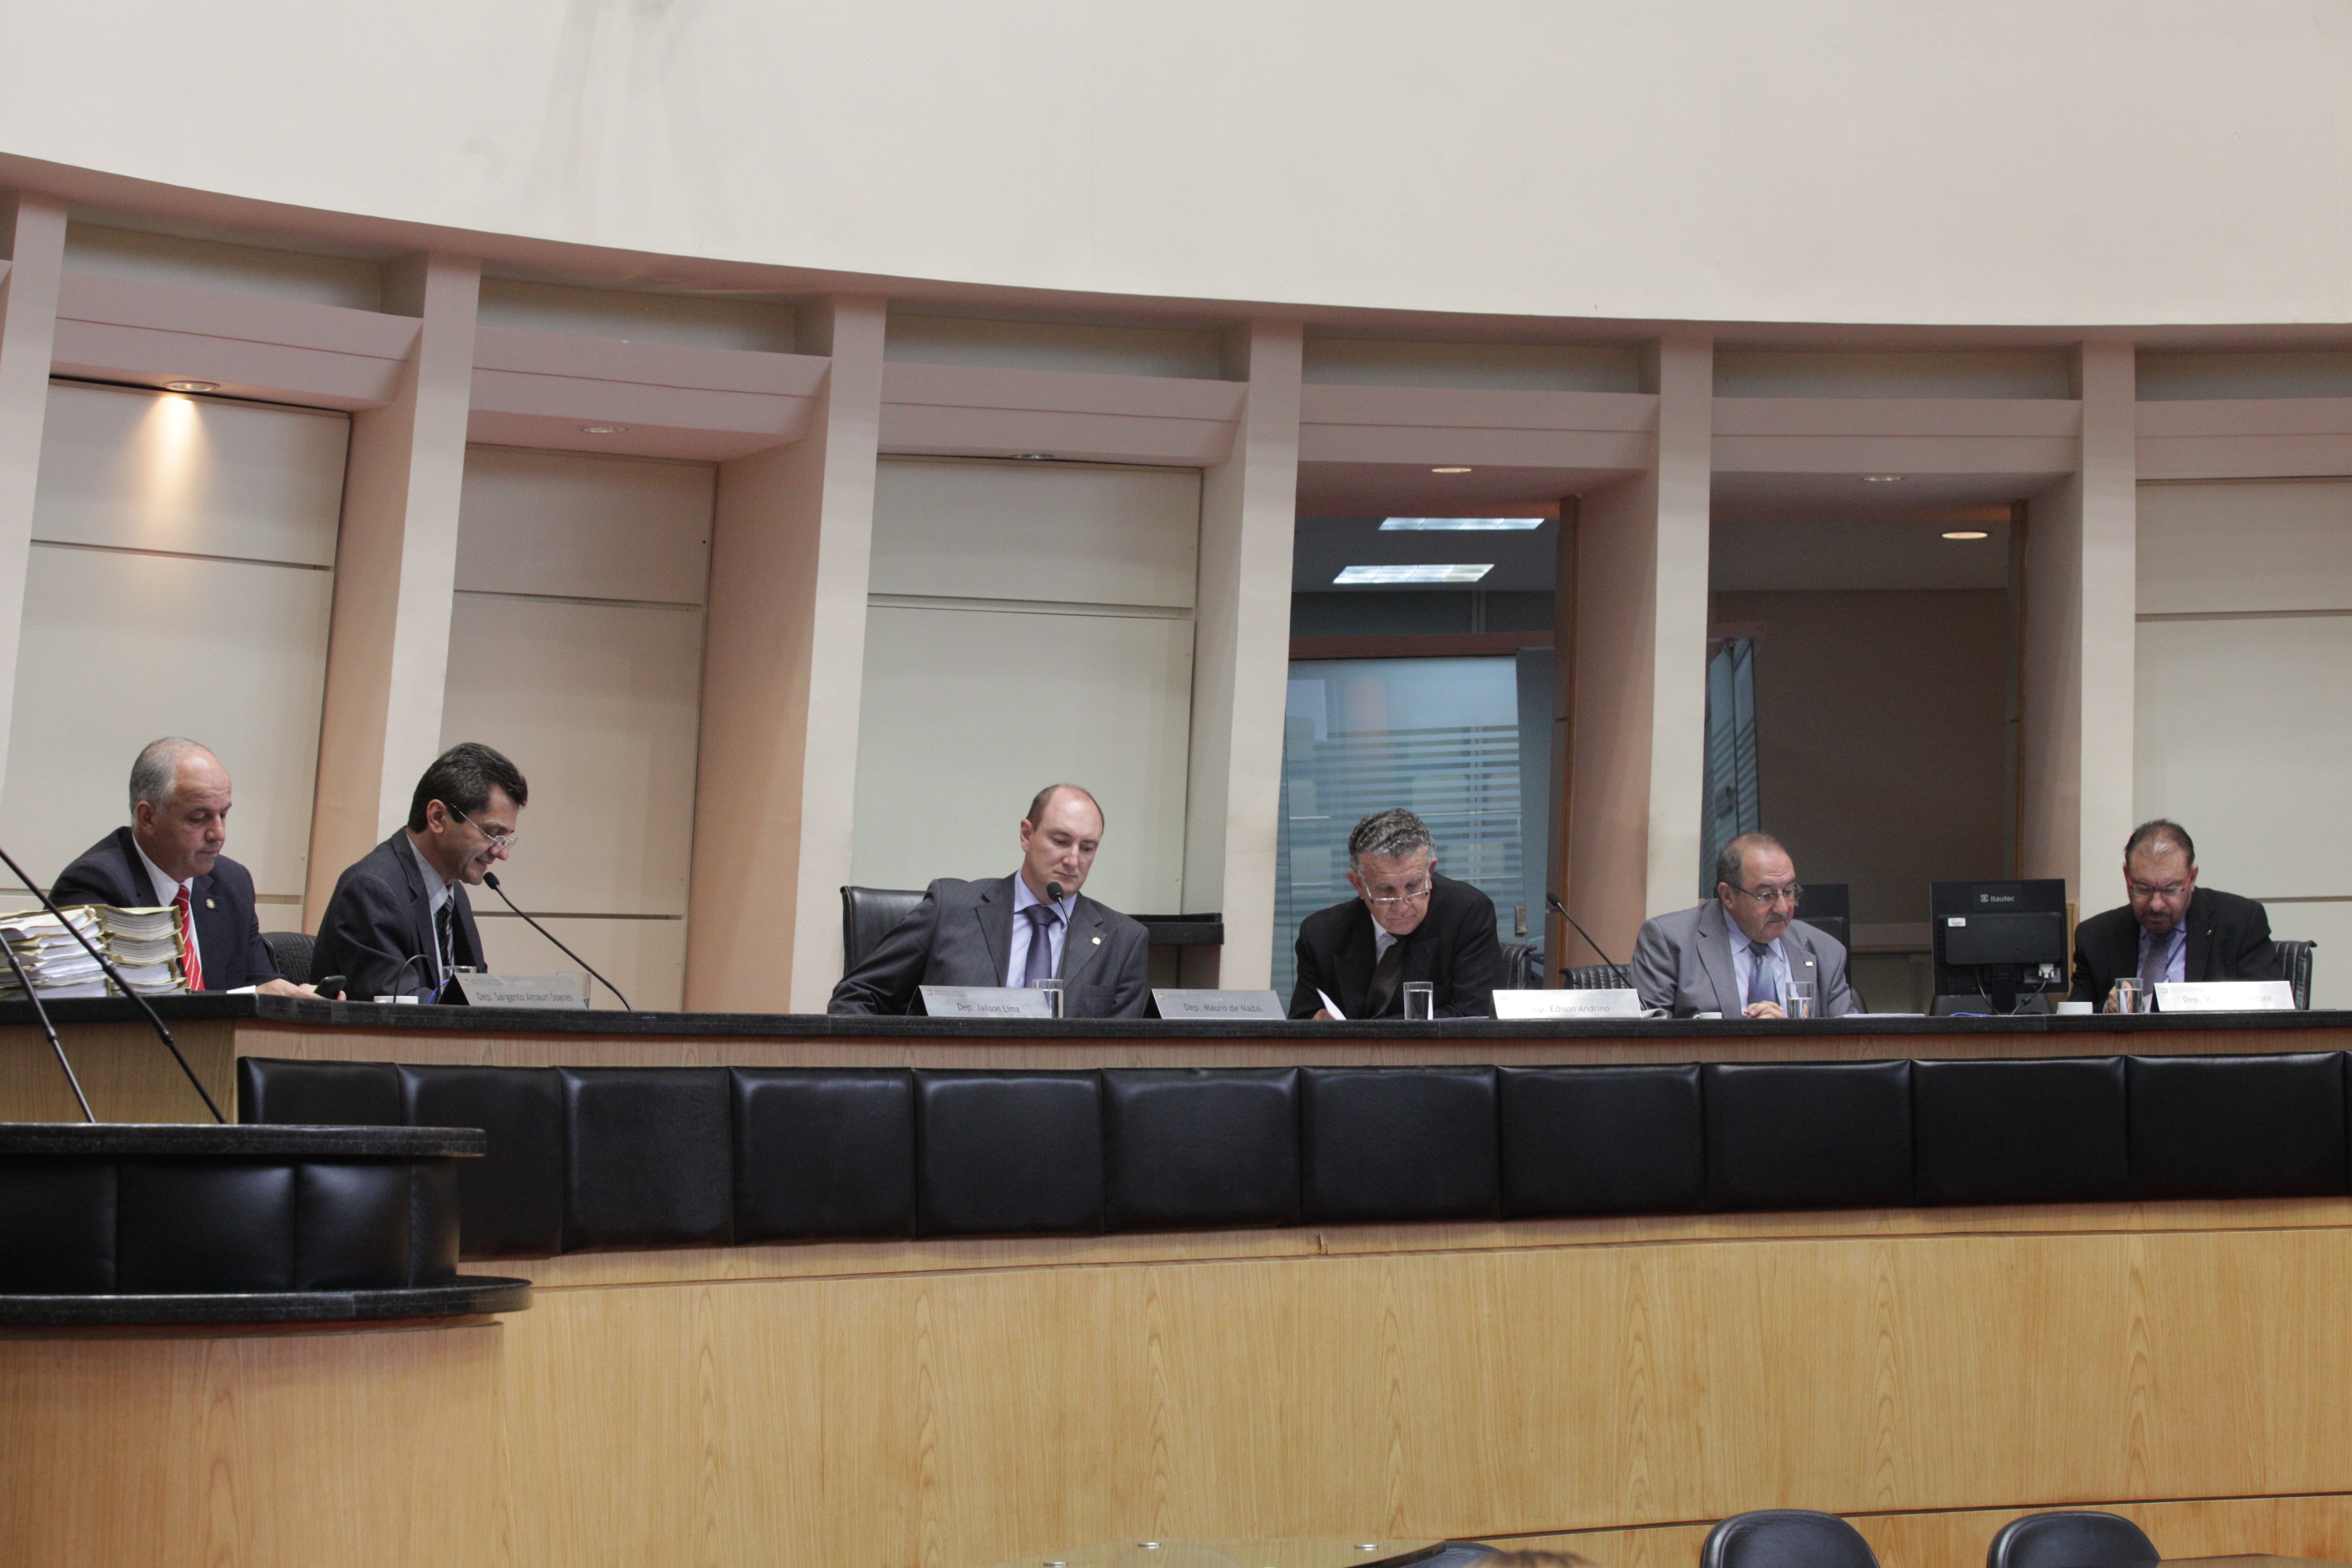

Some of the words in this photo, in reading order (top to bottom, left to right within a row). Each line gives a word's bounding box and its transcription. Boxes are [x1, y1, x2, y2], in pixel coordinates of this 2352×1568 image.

[476, 992, 494, 1002] Dep.
[495, 992, 525, 1004] Sargento
[526, 994, 550, 1002] Amauri
[551, 993, 574, 1002] Soares
[2183, 995, 2202, 1004] Dep.
[957, 1003, 975, 1012] Dep.
[977, 1004, 1002, 1012] Jailson
[1003, 1004, 1021, 1013] Lima
[1184, 1003, 1202, 1013] Dep.
[1205, 1004, 1228, 1012] Mauro
[1229, 1004, 1239, 1012] de
[1578, 1004, 1610, 1013] Andrino
